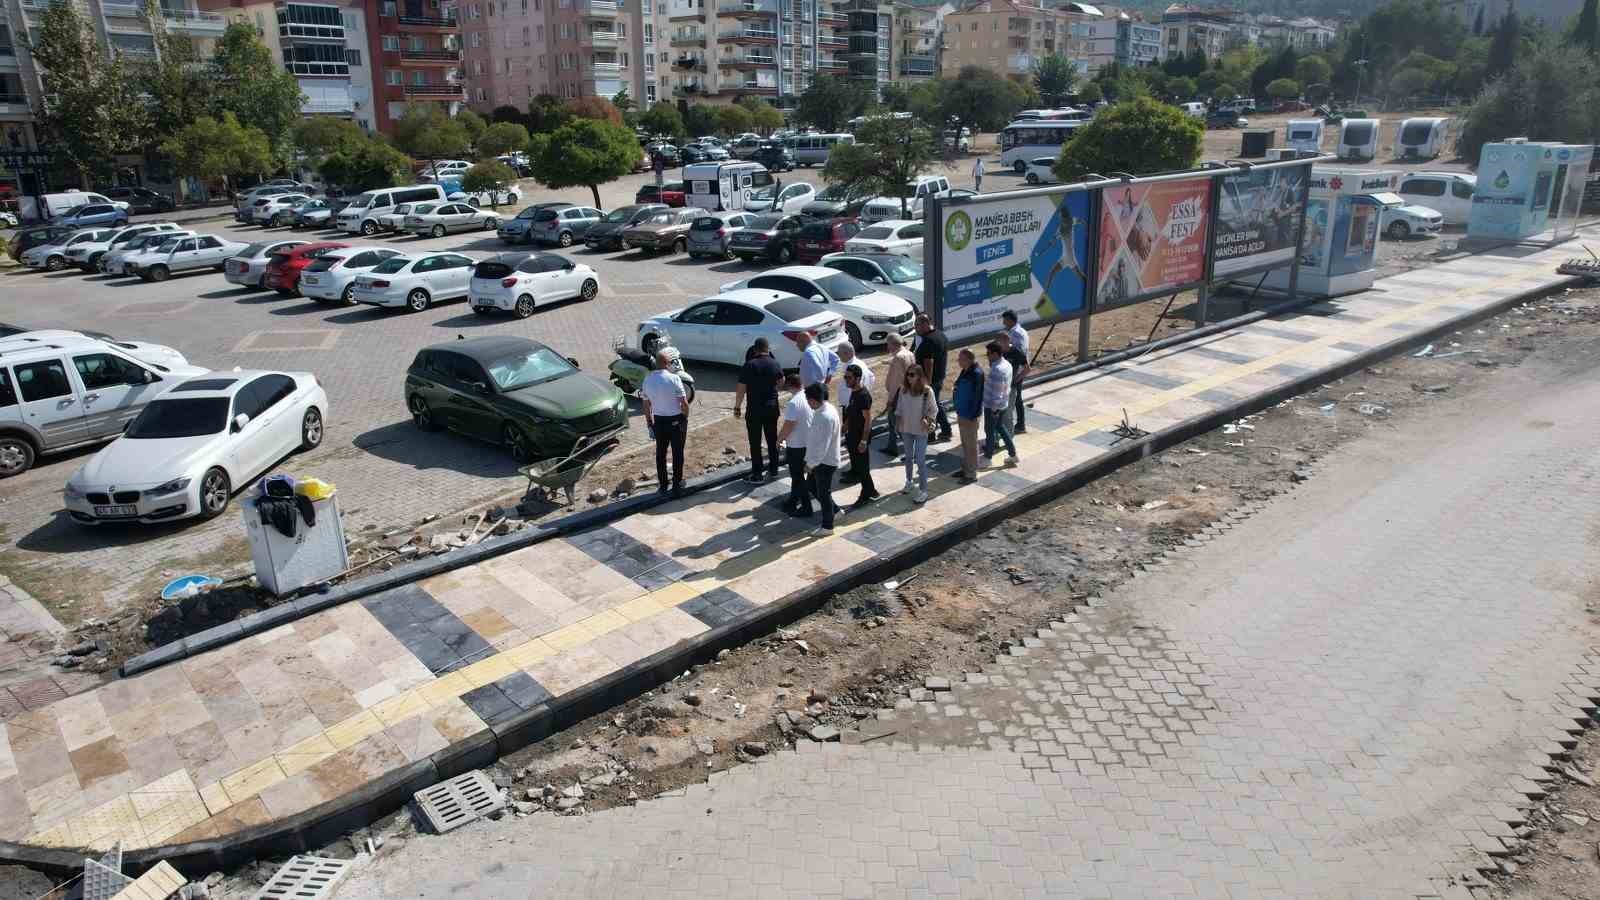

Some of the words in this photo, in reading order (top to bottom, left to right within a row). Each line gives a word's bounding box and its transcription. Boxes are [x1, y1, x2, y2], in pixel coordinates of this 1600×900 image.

[975, 212, 1009, 228] MANİSA
[975, 226, 1000, 240] SPOR
[1001, 220, 1041, 236] OKULLARI
[1170, 221, 1196, 239] FEST
